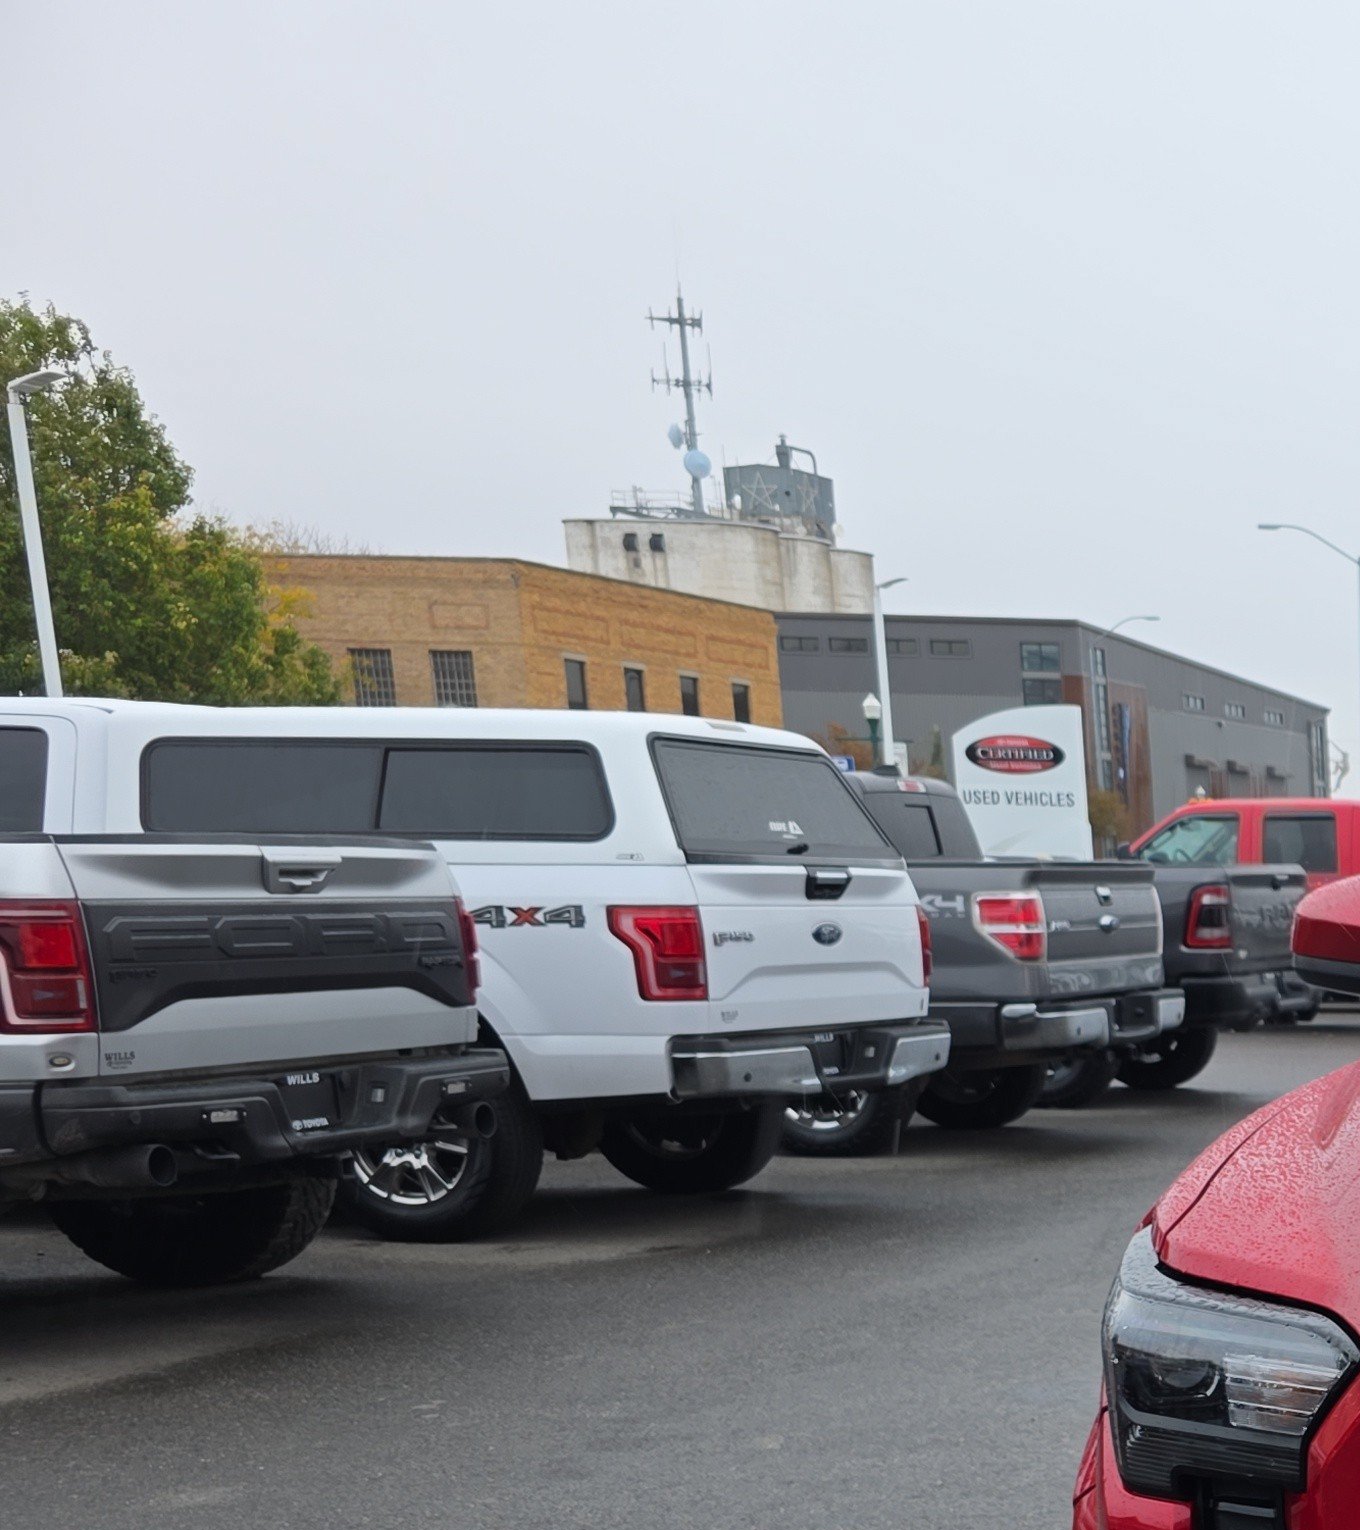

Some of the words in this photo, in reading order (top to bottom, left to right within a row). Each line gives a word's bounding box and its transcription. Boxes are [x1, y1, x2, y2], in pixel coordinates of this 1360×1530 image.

[976, 747, 1054, 760] CERTIFIED
[963, 789, 1000, 805] USED
[1004, 790, 1075, 807] VEHICLES
[102, 911, 458, 965] FORD
[104, 1051, 135, 1062] WILLS
[286, 1072, 320, 1086] WILLS
[302, 1117, 329, 1129] TOYOTA
